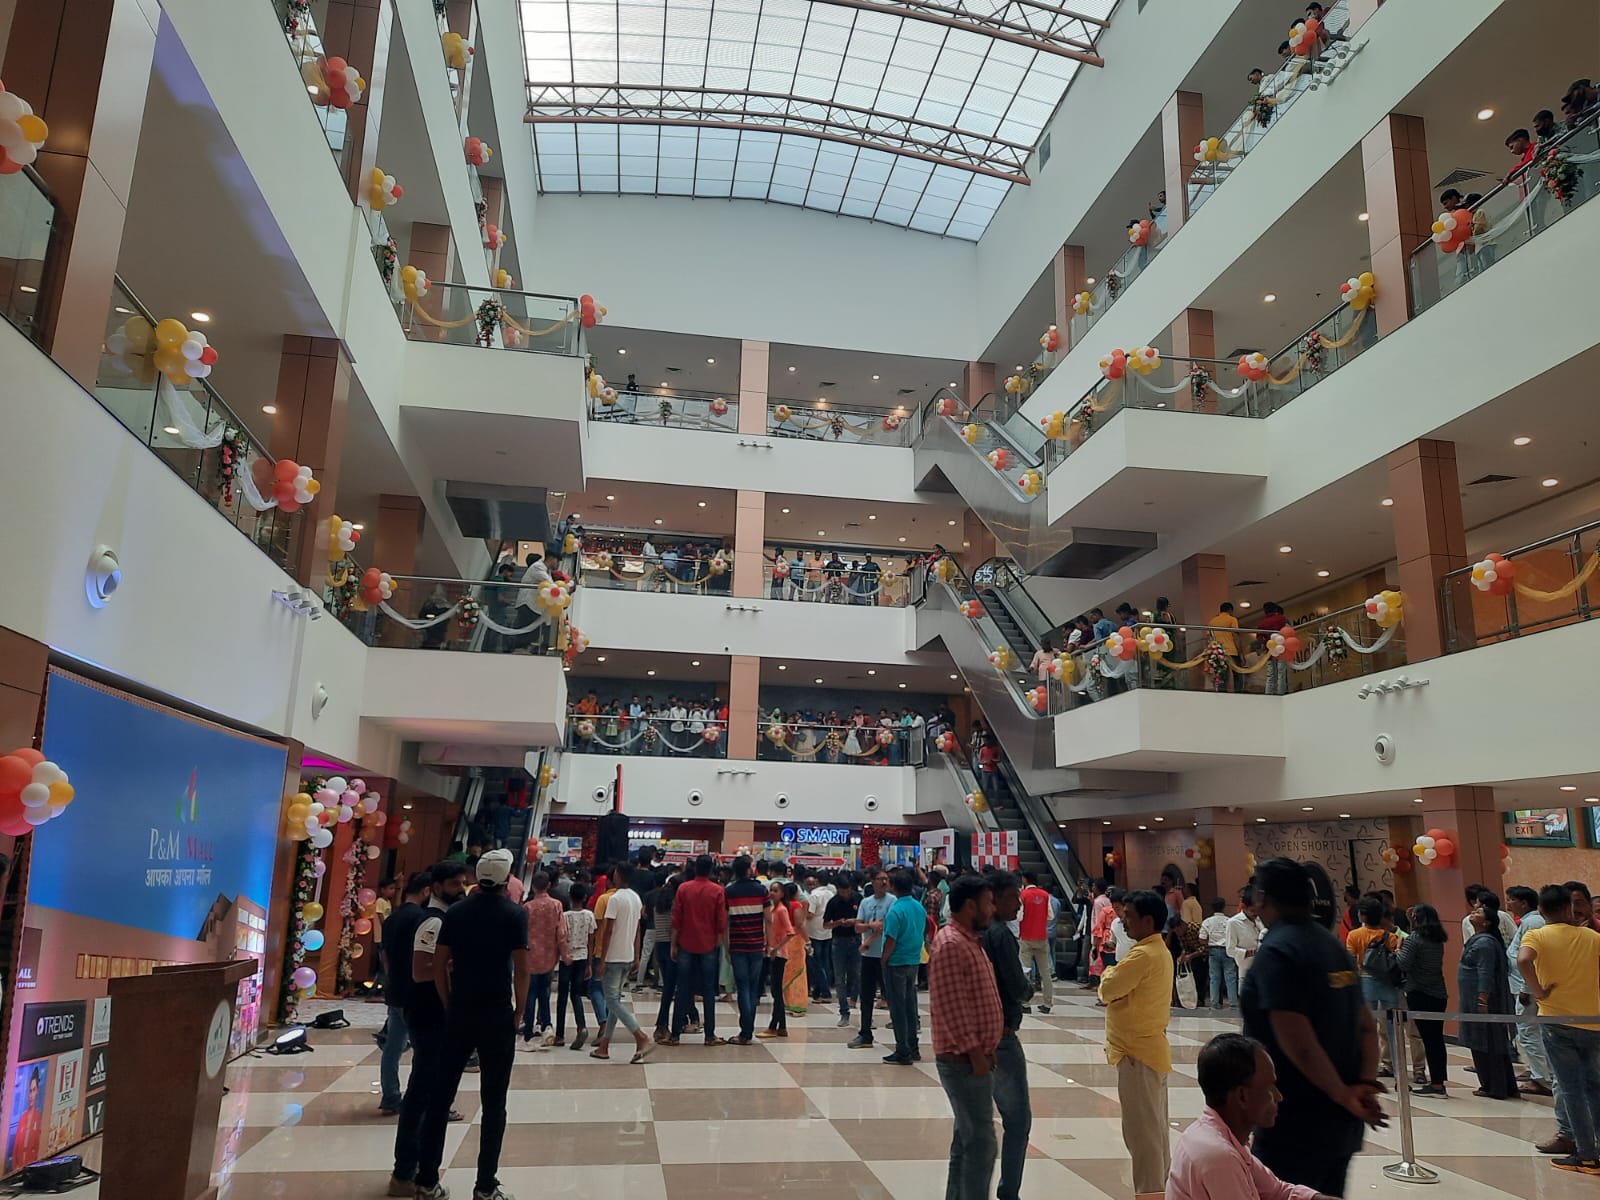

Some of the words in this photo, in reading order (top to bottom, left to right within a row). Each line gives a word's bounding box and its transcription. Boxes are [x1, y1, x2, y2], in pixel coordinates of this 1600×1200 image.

[797, 828, 849, 844] SMART
[1515, 826, 1534, 835] EXIT
[148, 828, 180, 860] P&M
[1274, 841, 1299, 852] OPEN
[1301, 840, 1347, 852] SHORTLY
[145, 868, 172, 887] आपका
[174, 868, 195, 887] अपना
[196, 864, 212, 886] मॉल
[44, 1015, 74, 1034] TRENDS
